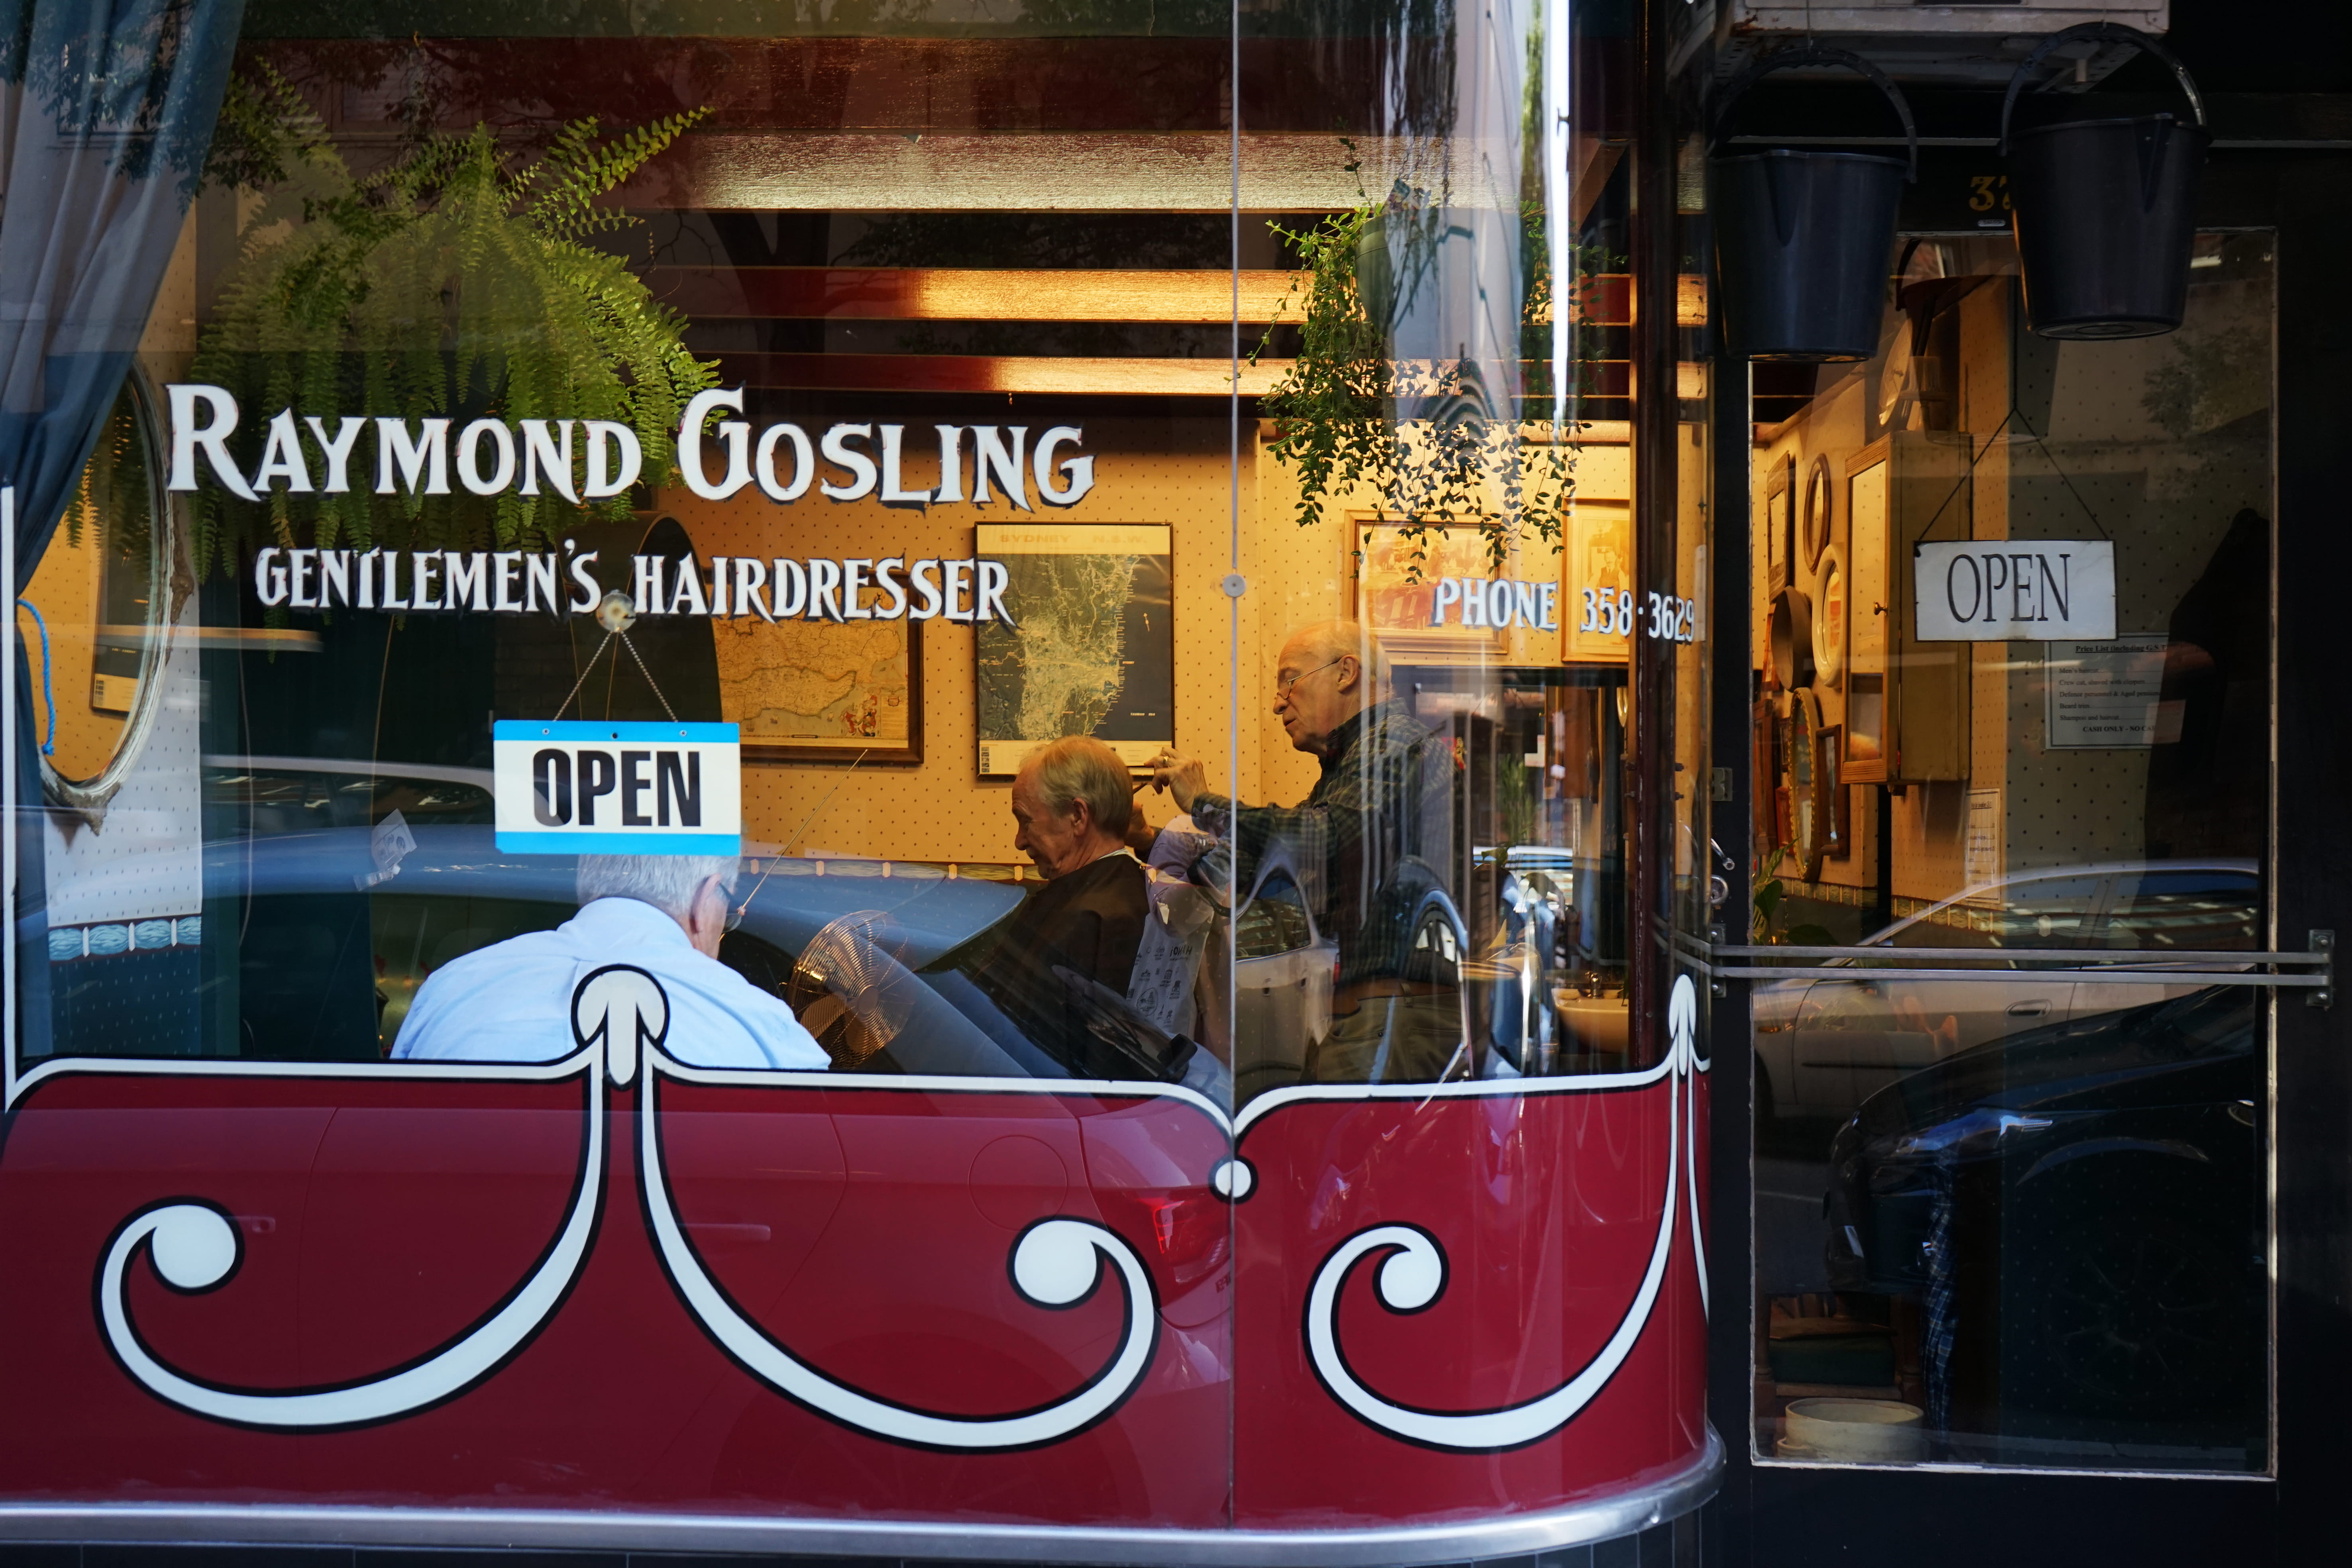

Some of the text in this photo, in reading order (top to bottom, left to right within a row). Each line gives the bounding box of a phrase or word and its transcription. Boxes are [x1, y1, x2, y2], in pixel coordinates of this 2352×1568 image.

[167, 384, 1097, 512] RAYMOND GOSLING
[1000, 534, 1147, 543] SYDNEY N.S.W.
[255, 539, 1014, 625] GENTLEMEN'S HAIRDRESSER
[1433, 577, 1558, 631] PHONE
[1947, 553, 2071, 623] OPEN
[532, 748, 701, 828] OPEN
